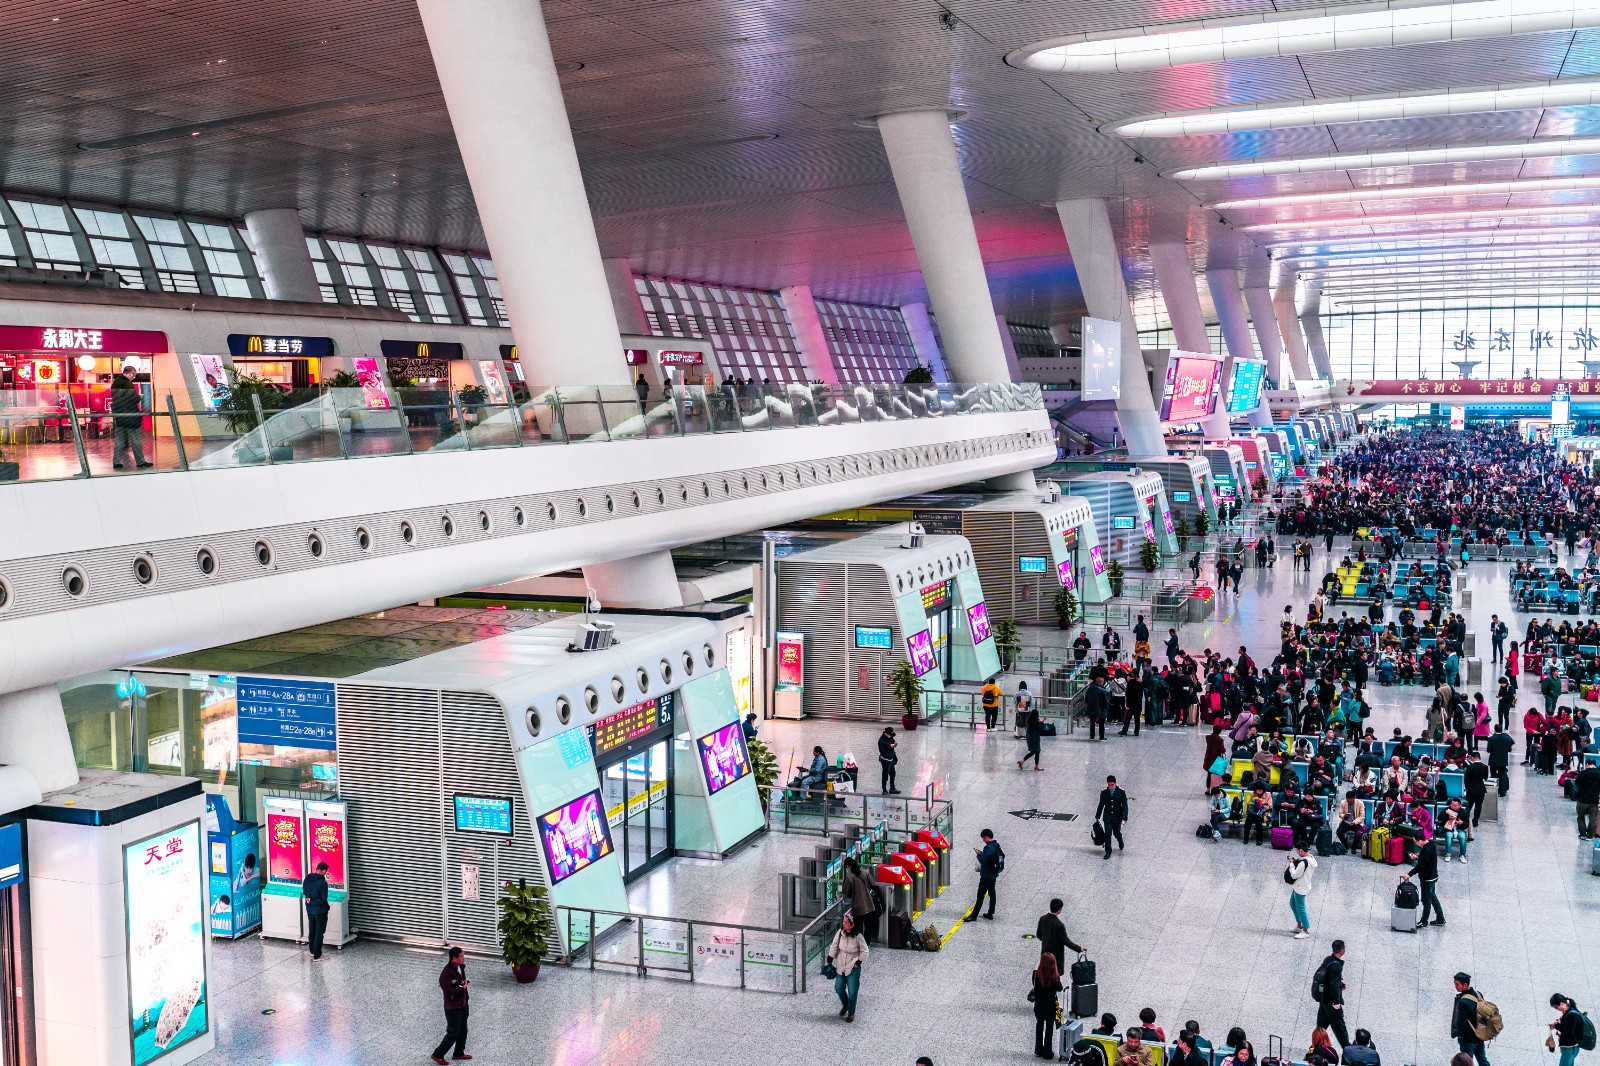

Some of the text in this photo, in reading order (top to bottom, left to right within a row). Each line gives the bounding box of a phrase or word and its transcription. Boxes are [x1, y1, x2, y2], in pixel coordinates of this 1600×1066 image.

[42, 329, 103, 350] 永和大王
[263, 339, 303, 354] 麦当劳
[1401, 382, 1542, 394] 不忘初心 牢记使命
[144, 837, 184, 866] 天堂
